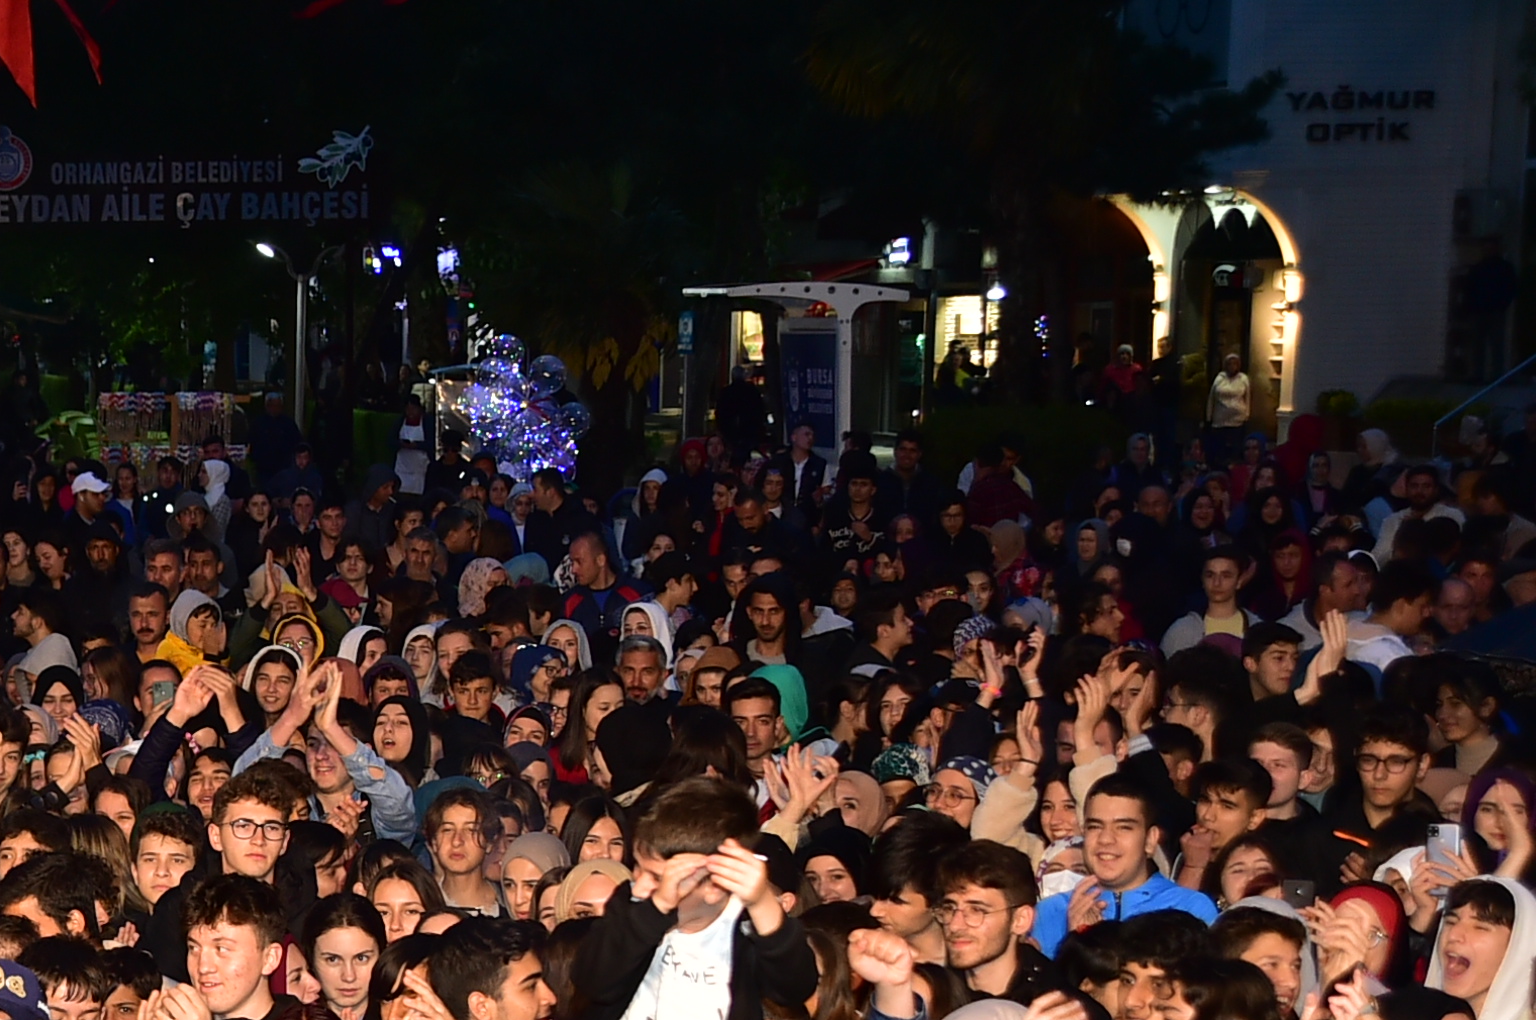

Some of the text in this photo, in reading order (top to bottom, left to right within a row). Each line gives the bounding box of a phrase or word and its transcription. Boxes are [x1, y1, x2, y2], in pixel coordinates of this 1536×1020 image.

[1286, 85, 1436, 112] YAĞMUR
[1306, 117, 1410, 143] OPTİK
[50, 154, 164, 185] ORHANGAZİ
[171, 153, 284, 184] BELEDİYESİ
[100, 186, 165, 223] AİLE
[175, 191, 233, 229] ÇAY
[240, 183, 369, 229] BAHÇESİ
